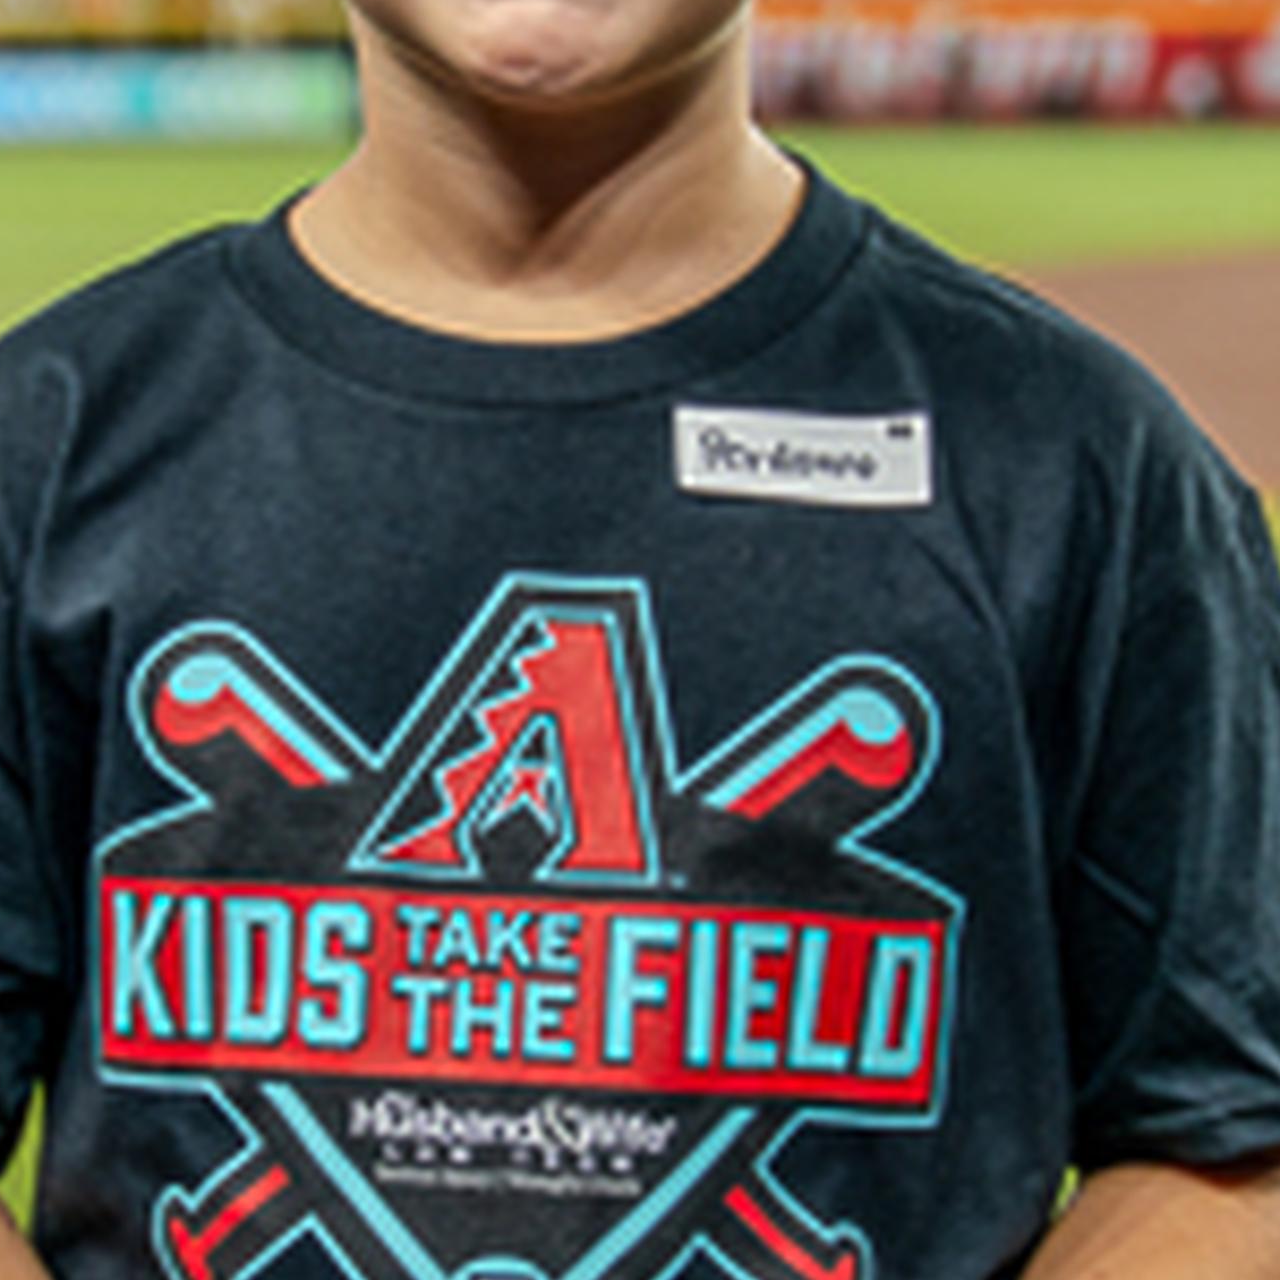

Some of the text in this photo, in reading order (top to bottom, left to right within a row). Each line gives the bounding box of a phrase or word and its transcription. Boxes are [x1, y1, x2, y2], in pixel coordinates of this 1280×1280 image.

[109, 889, 933, 1079] KIDS TAKE THE FIELD
